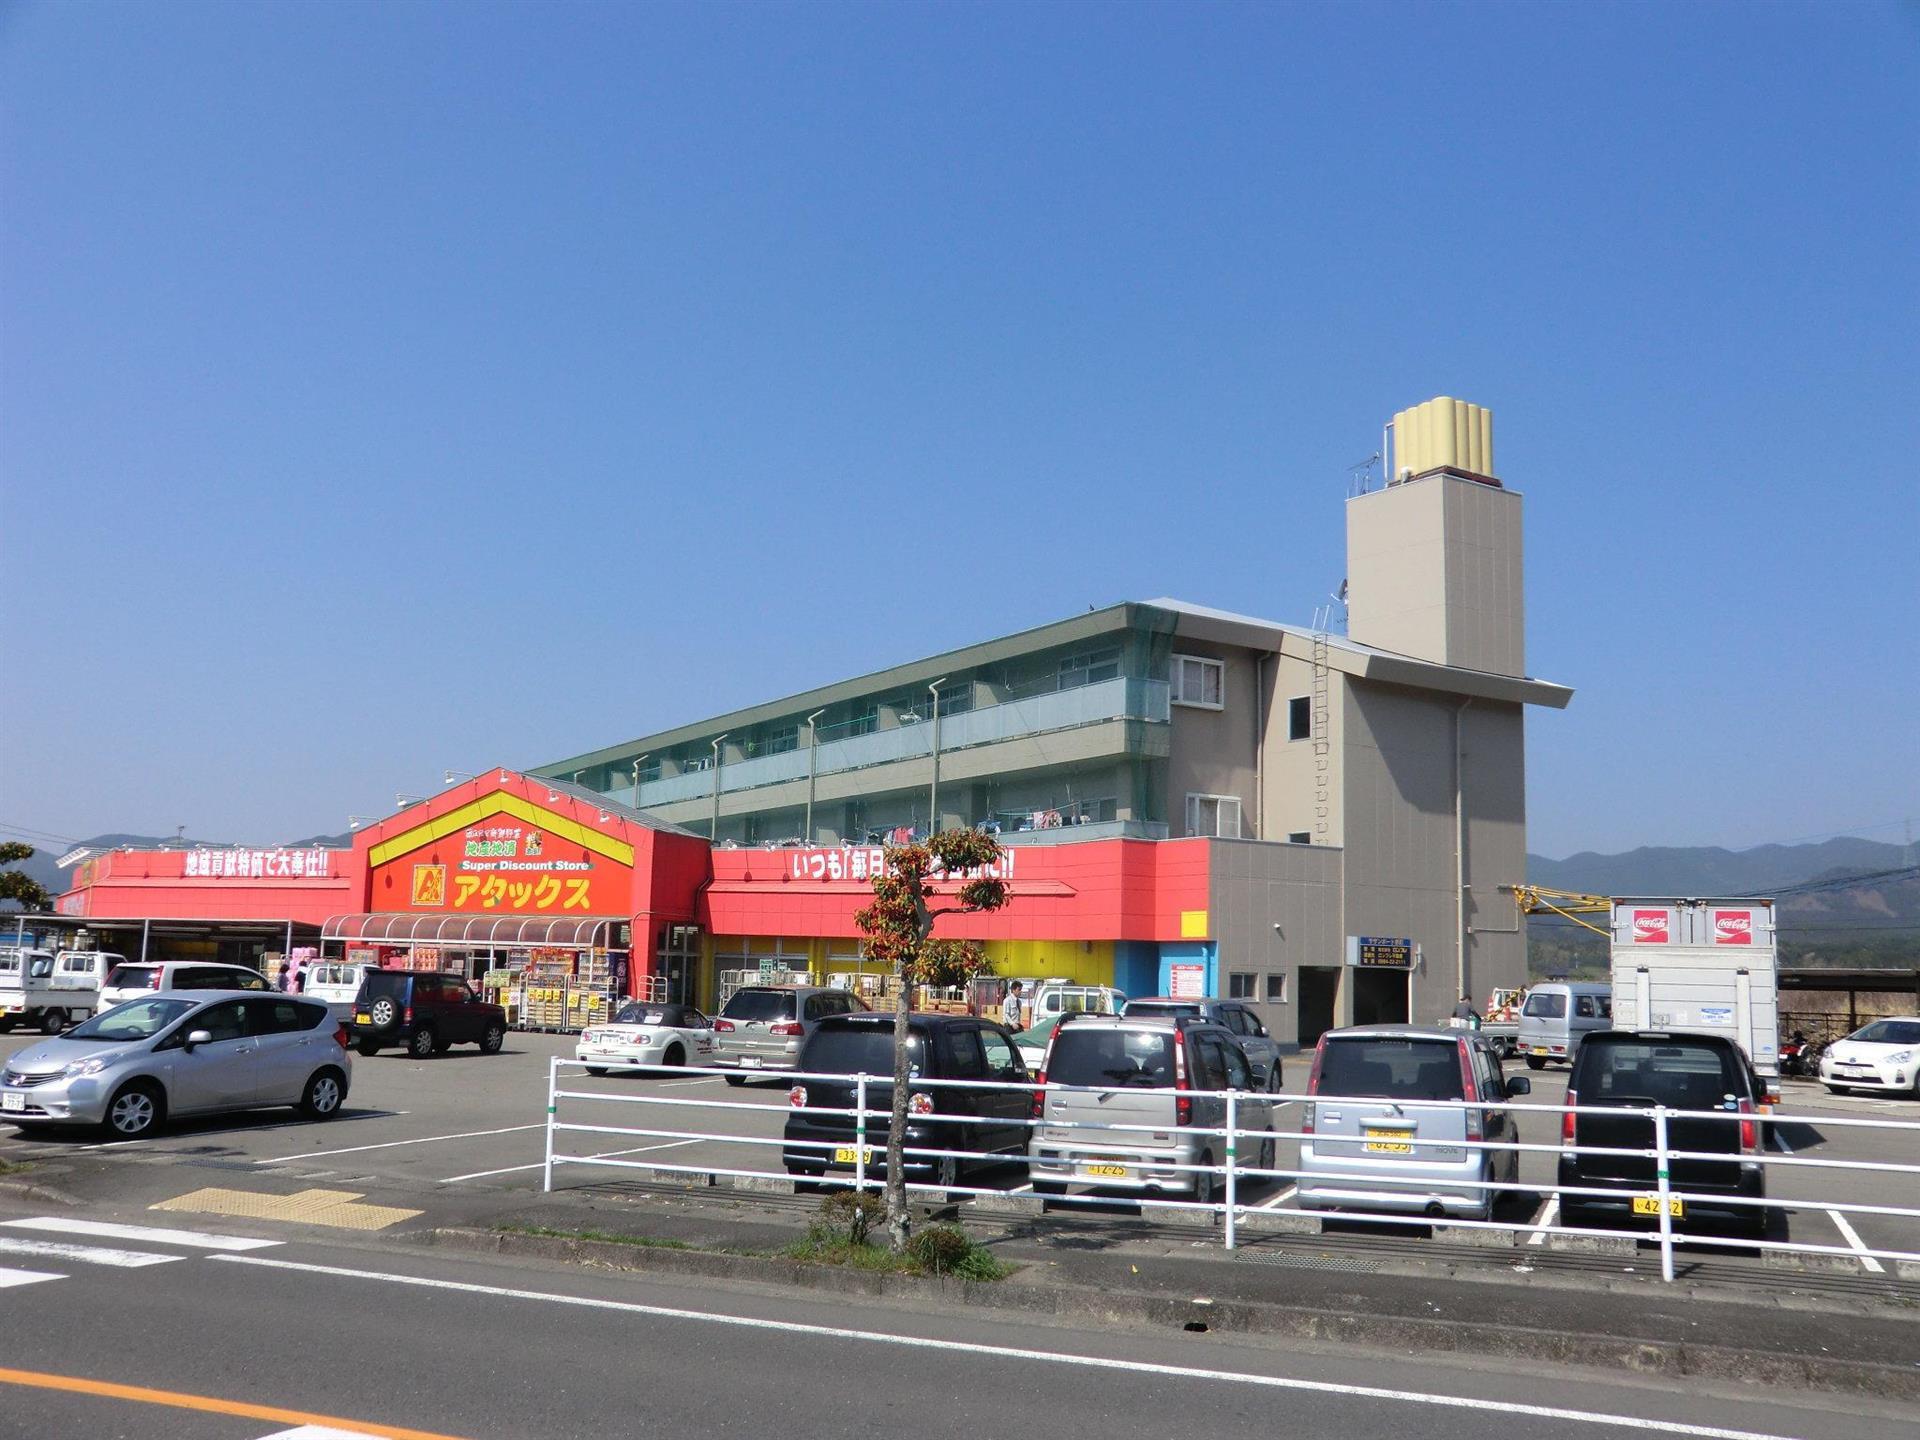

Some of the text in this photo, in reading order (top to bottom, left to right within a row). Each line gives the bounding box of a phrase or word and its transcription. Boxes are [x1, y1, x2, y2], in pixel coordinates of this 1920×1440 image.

[462, 860, 589, 871] Super Discount Store
[453, 874, 591, 910] アタックス
